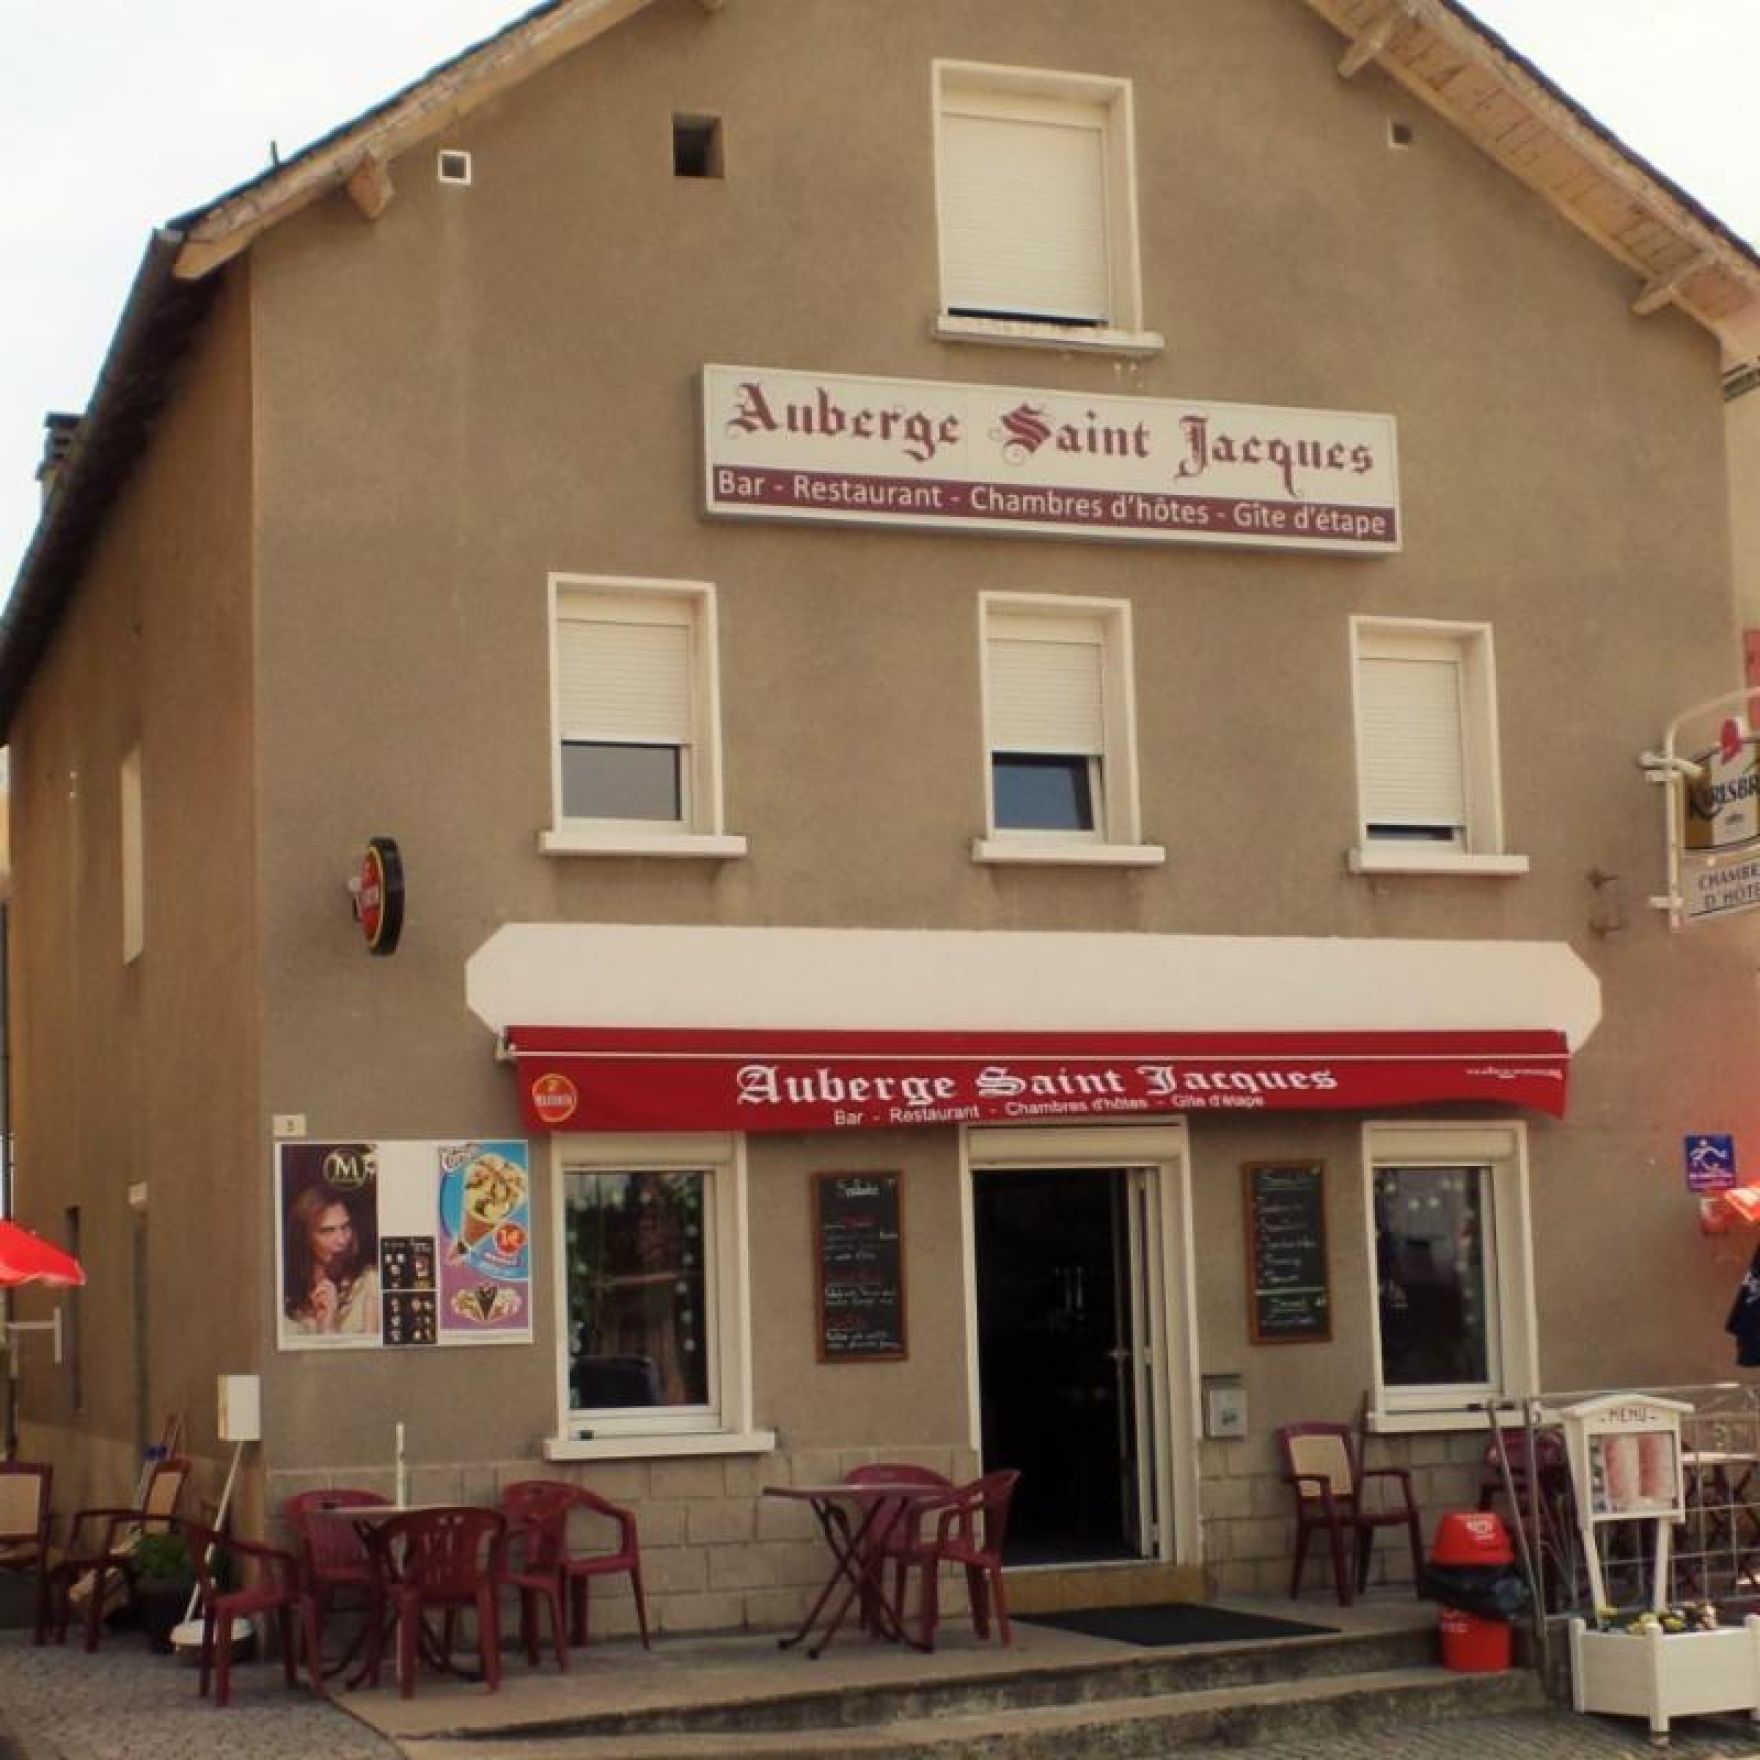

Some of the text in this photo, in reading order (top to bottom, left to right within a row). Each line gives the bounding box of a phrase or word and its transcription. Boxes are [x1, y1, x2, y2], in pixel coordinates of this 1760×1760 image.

[727, 382, 1373, 496] Auberge Saint Jacques
[718, 470, 765, 496] Bar
[793, 474, 943, 508] Restaurant
[971, 485, 1102, 518] Chambres
[1112, 494, 1209, 525] d'hôtes
[1296, 505, 1385, 537] d'étape
[737, 1064, 1338, 1107] Auberge Saint Jacques
[833, 1109, 863, 1125] Bar
[890, 1104, 980, 1122] Restaurant
[1005, 1101, 1088, 1117] Chambres
